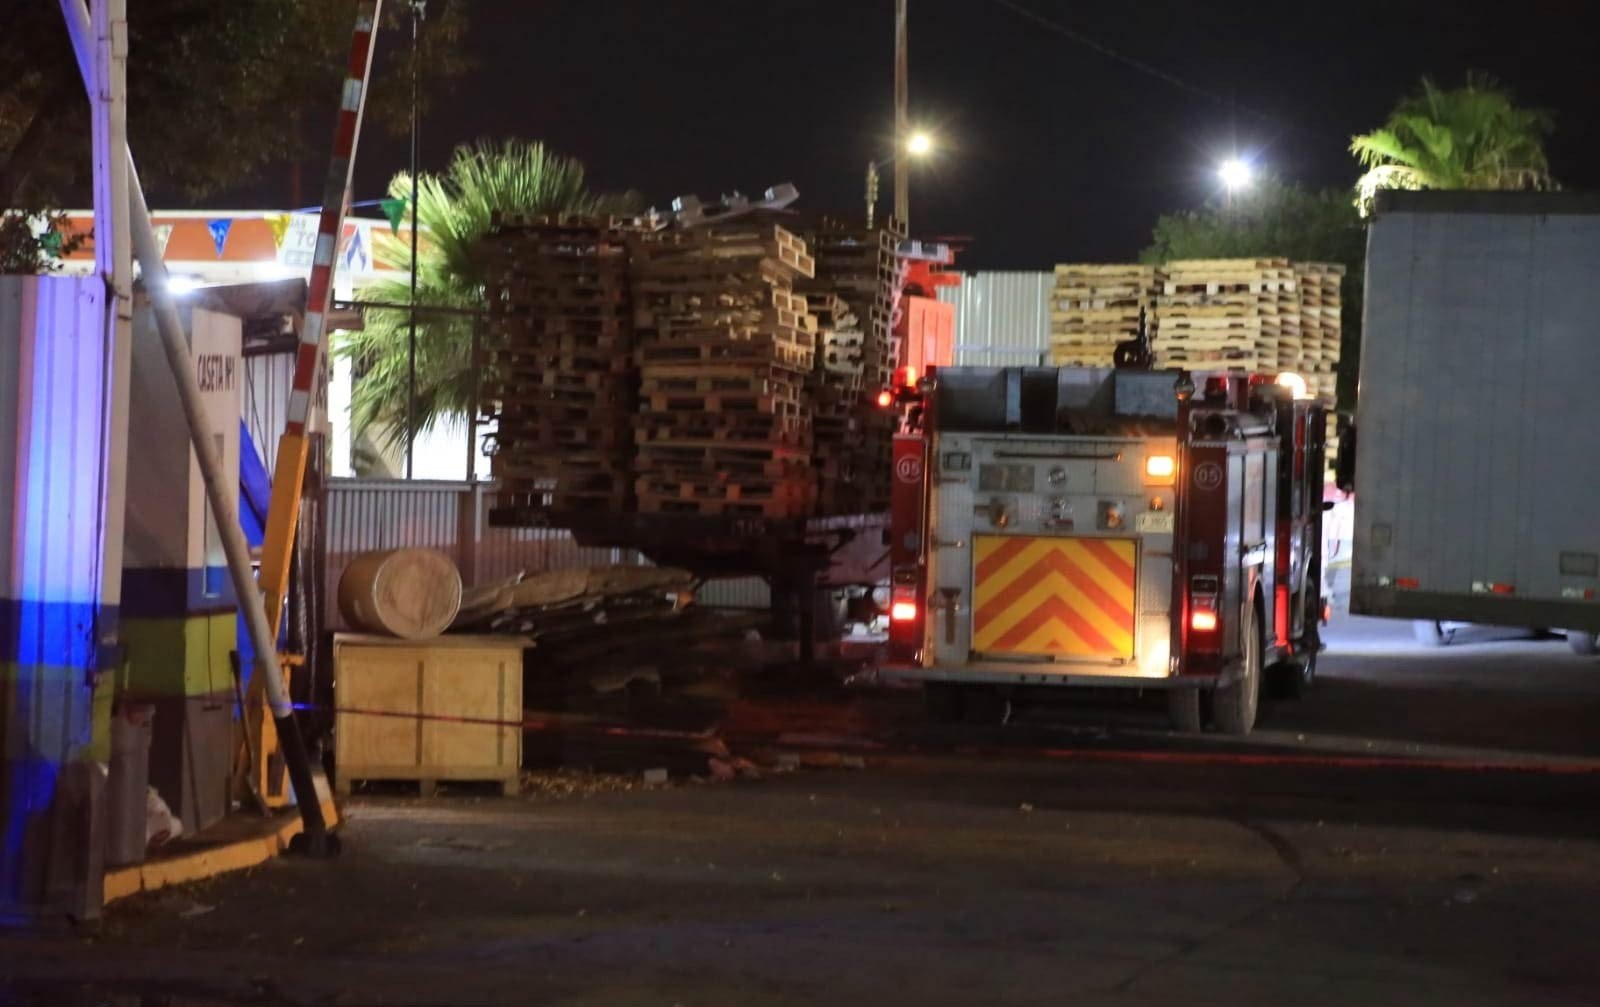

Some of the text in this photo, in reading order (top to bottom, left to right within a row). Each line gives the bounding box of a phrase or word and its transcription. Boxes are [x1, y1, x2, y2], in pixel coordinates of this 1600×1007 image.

[197, 353, 224, 392] CASETA
[900, 461, 920, 478] 05
[1198, 467, 1219, 483] 05
